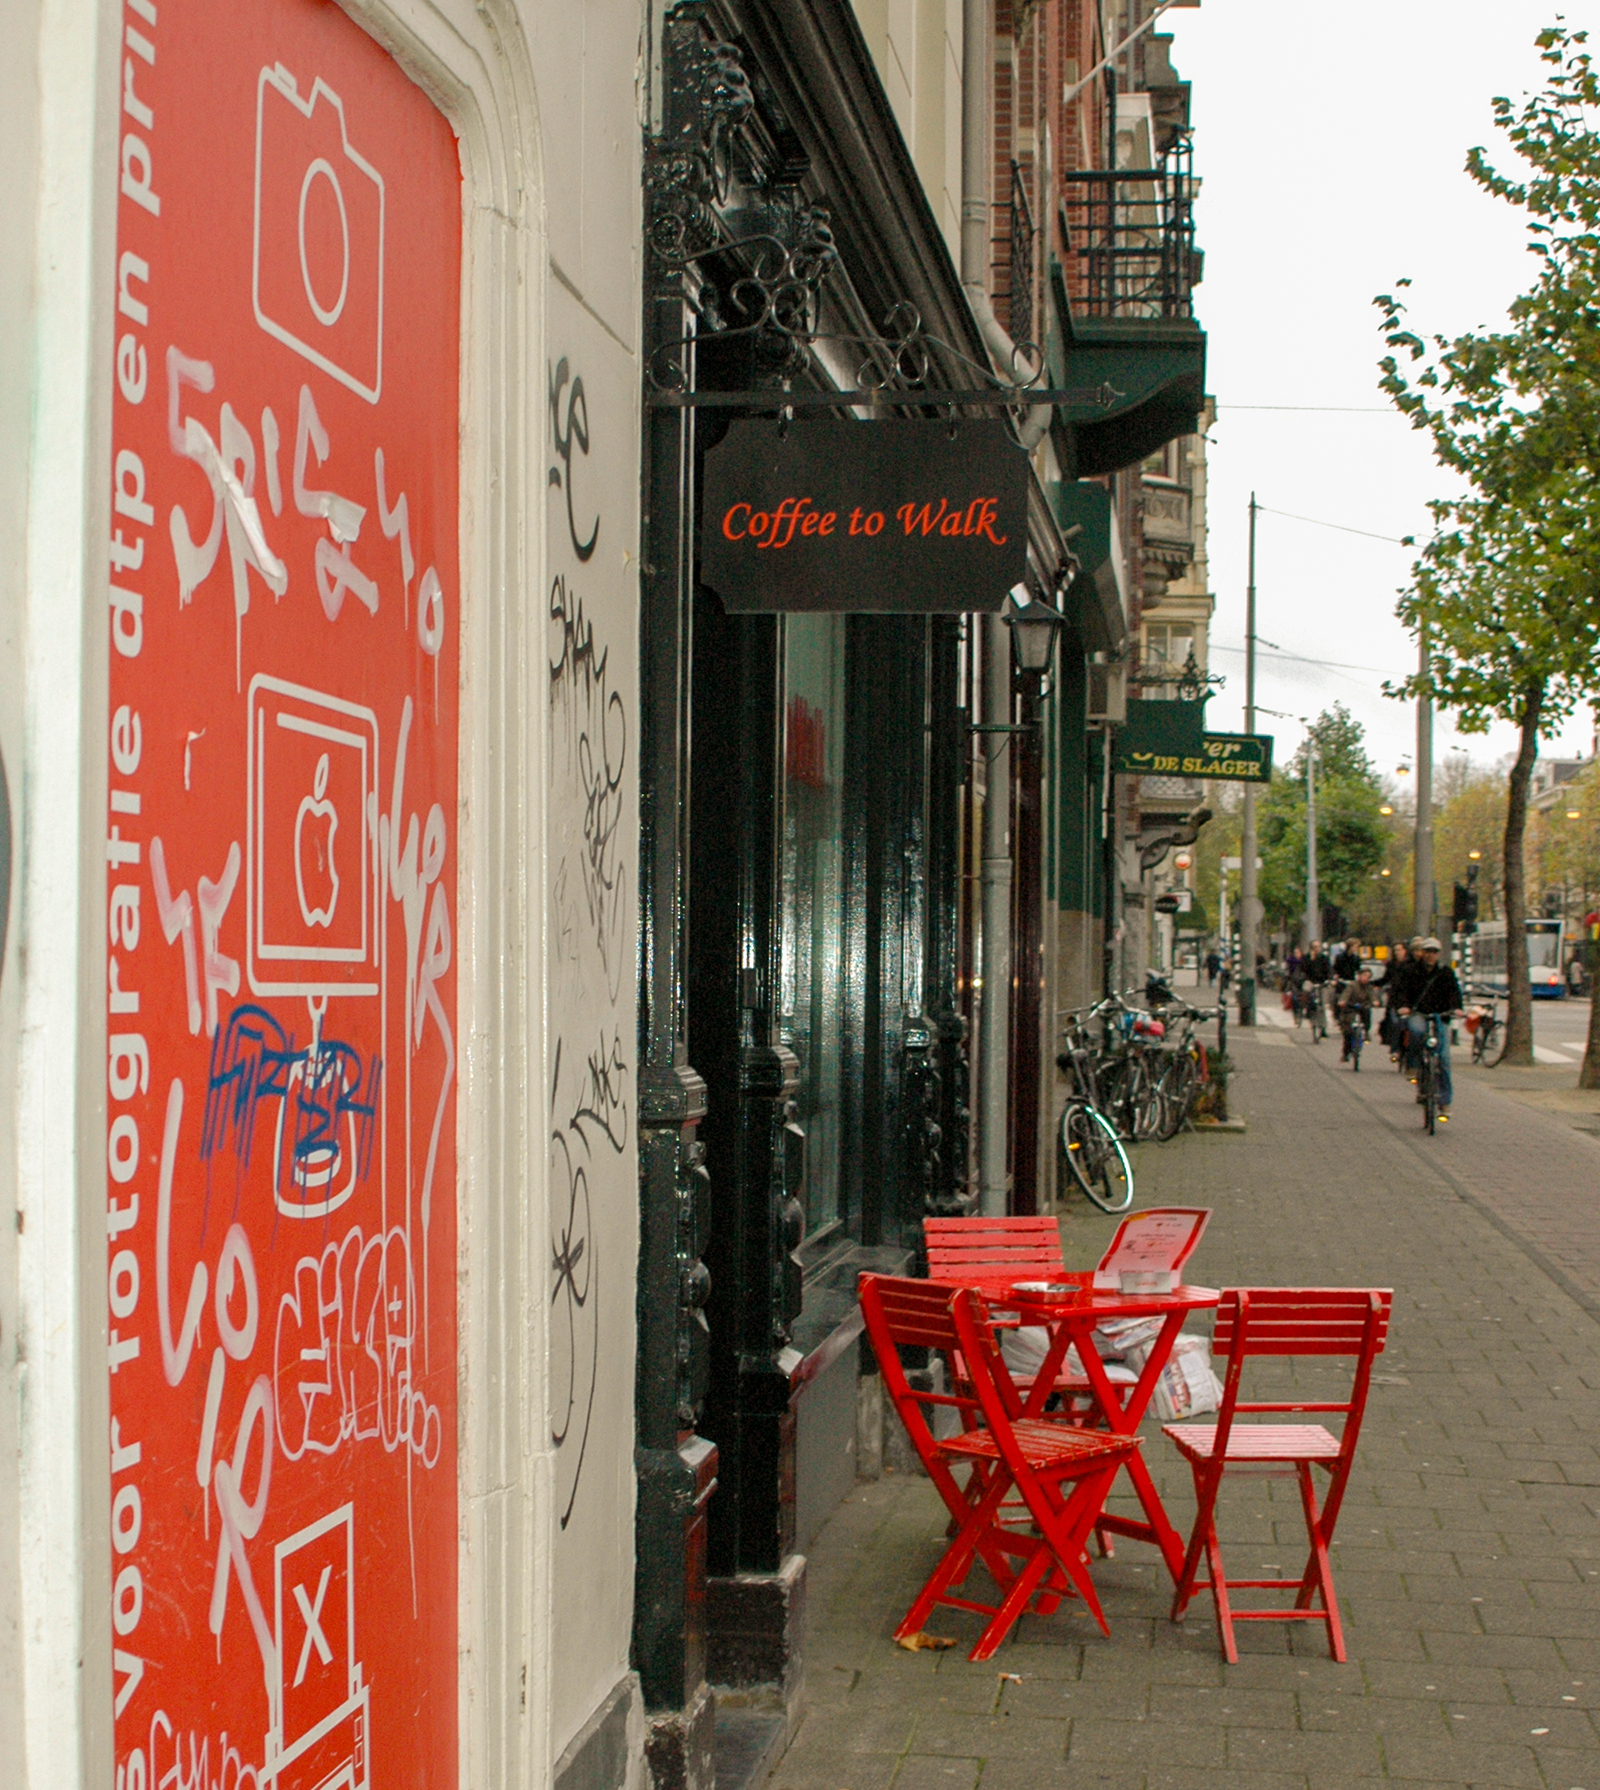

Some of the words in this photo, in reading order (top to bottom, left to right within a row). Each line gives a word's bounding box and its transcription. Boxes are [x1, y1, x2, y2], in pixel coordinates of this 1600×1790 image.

[117, 250, 149, 405] en
[108, 449, 154, 658] dtp
[722, 498, 837, 548] Coffee
[849, 506, 885, 536] to
[896, 498, 1007, 545] Walk
[1152, 755, 1180, 771] DE
[1181, 757, 1262, 776] SLAGER
[107, 704, 150, 1374] fotografie
[111, 1415, 145, 1720] voor
